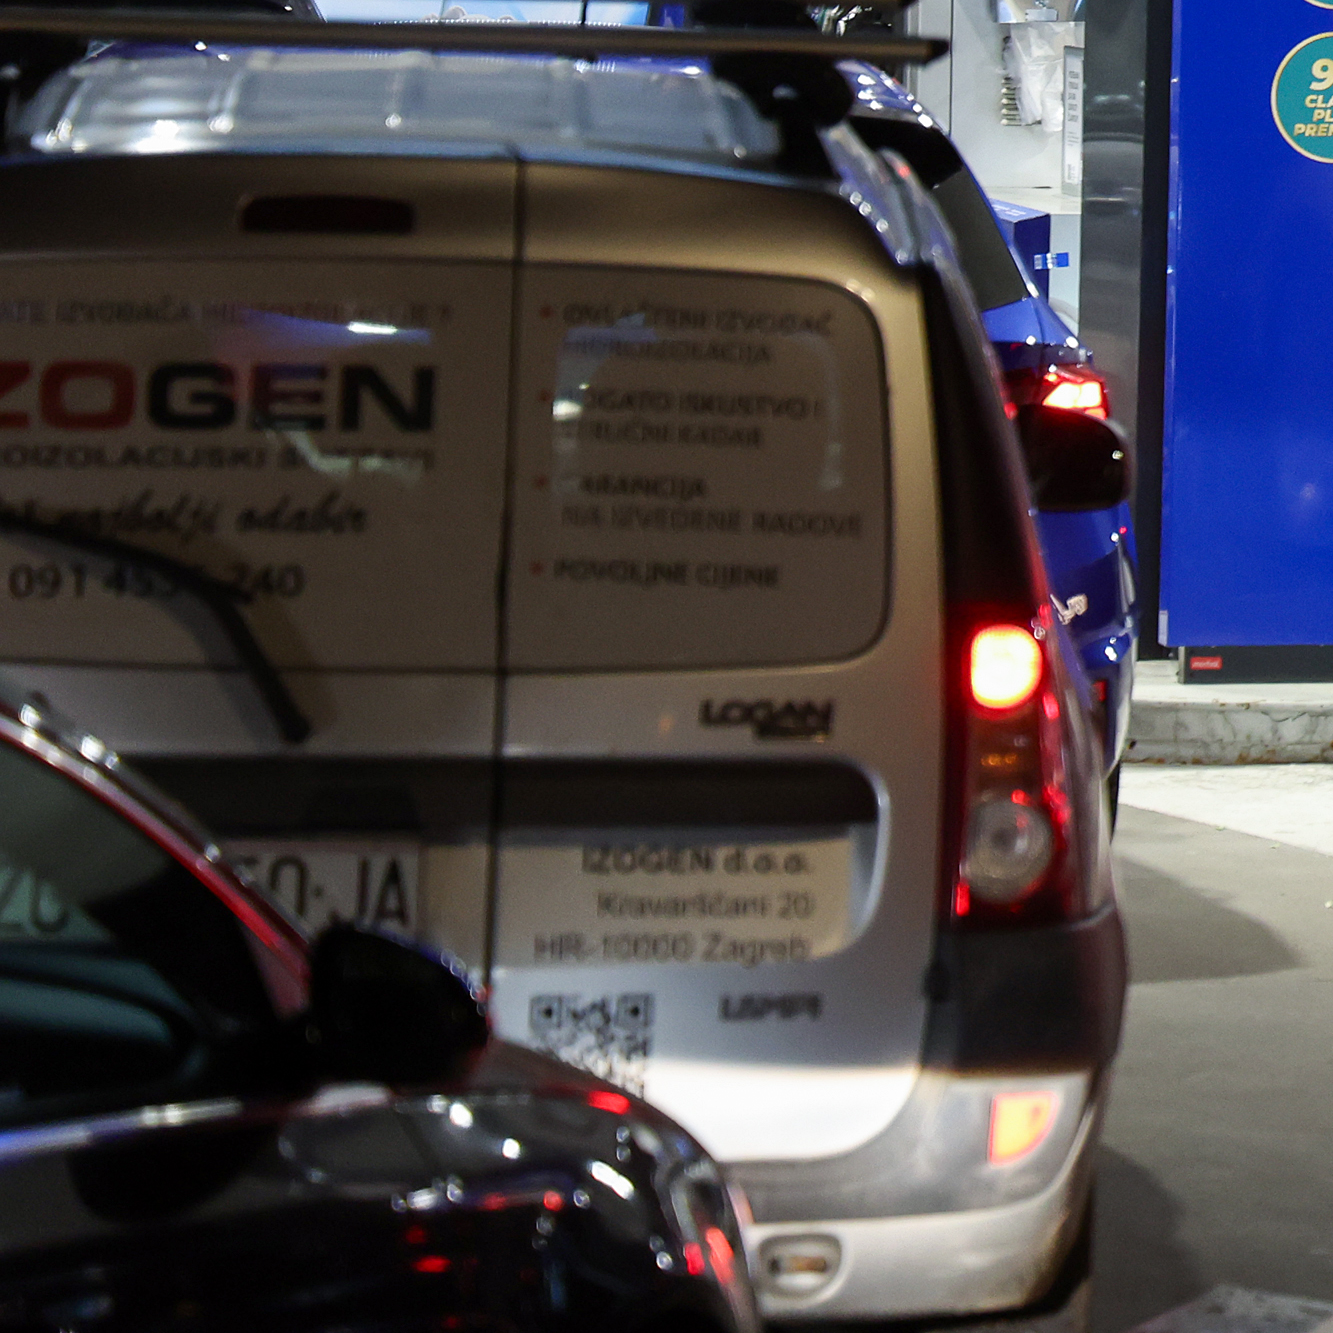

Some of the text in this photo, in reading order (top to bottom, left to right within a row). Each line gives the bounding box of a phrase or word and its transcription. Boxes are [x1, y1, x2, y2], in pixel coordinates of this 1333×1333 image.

[562, 388, 674, 414] OGATO
[699, 697, 836, 727] LOGAN
[582, 845, 717, 875] IZOGEN
[701, 931, 810, 969] Zagreb
